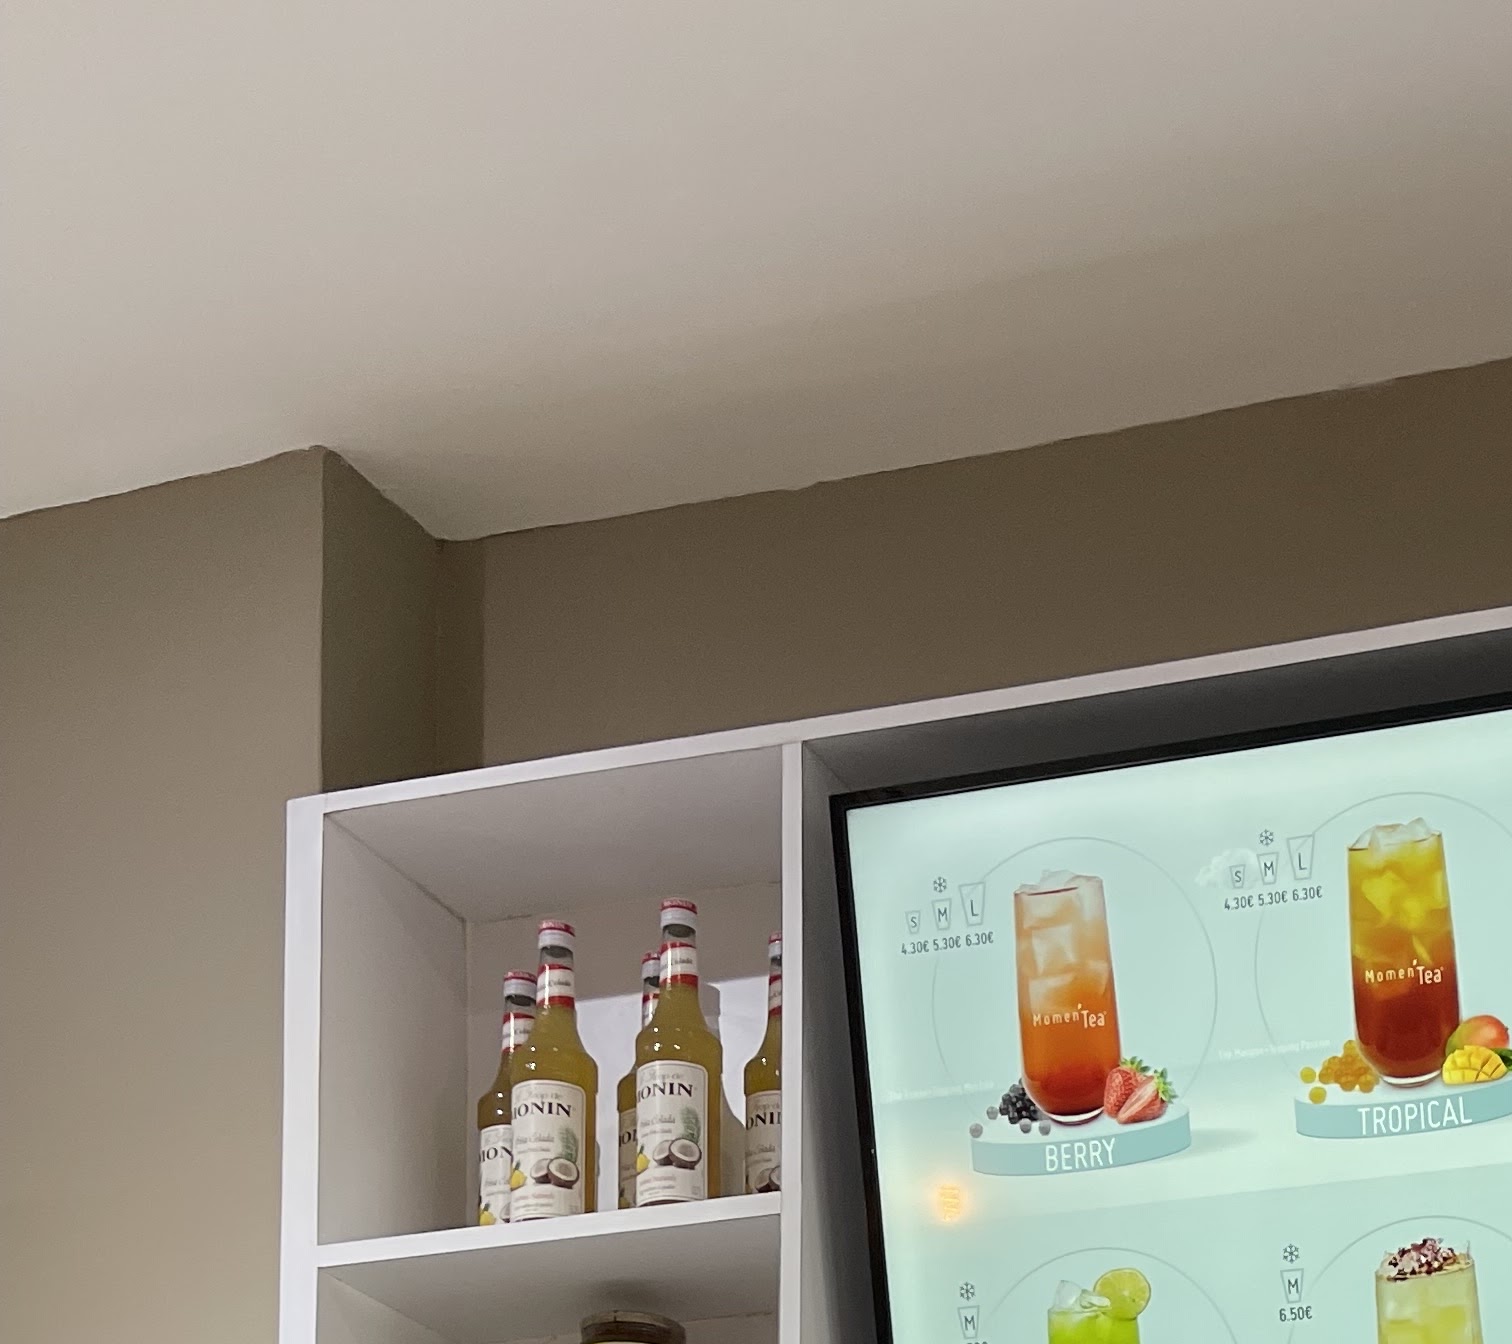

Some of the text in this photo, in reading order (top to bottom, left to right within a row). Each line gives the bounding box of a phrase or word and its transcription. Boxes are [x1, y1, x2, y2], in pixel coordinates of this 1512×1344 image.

[1234, 852, 1308, 883] S M L
[1224, 885, 1323, 911] 4.30€ 5.30€ 6.30€
[910, 899, 979, 928] S M L
[901, 931, 994, 955] 4.30€ 5.30€ 6.30€
[1357, 1098, 1473, 1137] TROPICAL
[1044, 1137, 1117, 1173] BERRY
[1286, 1276, 1300, 1295] M
[962, 1313, 977, 1332] M
[1278, 1304, 1313, 1322] 6.50€
